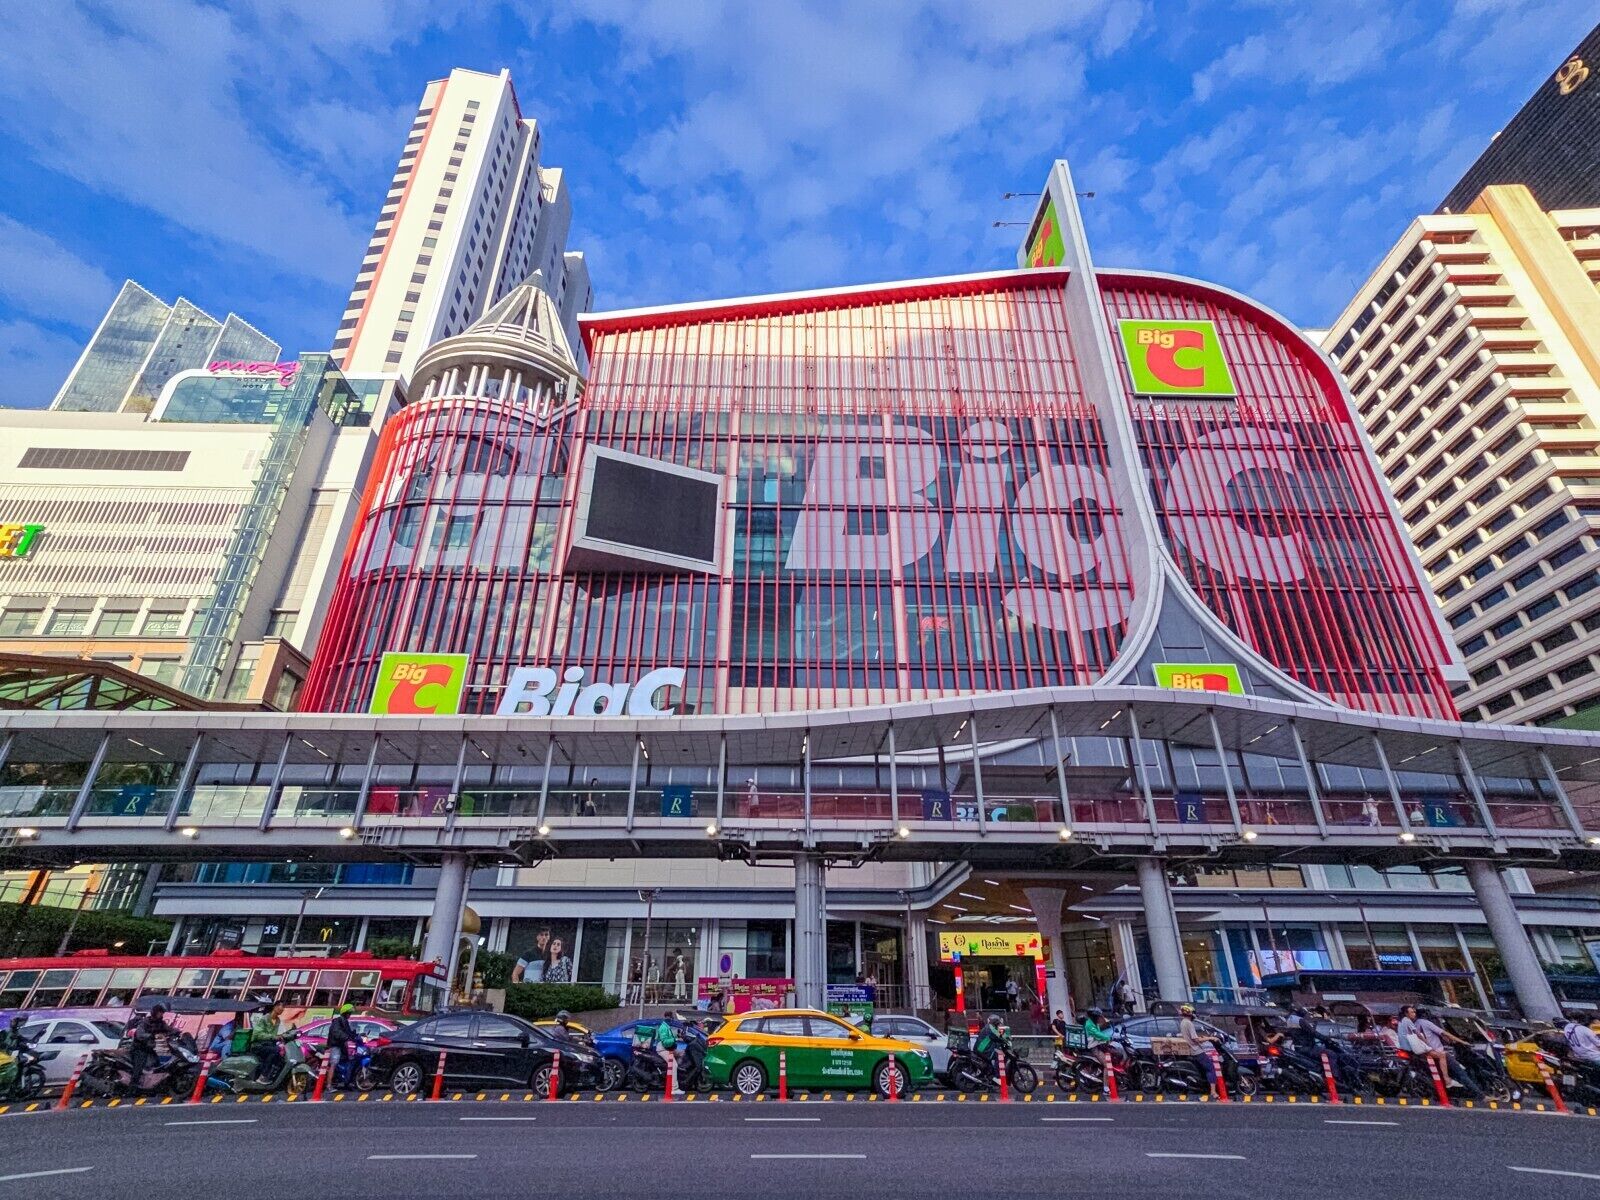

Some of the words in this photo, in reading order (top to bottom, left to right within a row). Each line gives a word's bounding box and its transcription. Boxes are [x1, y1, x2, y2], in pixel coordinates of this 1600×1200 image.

[1137, 328, 1175, 349] Big
[1146, 329, 1204, 387] C
[387, 663, 454, 714] C
[390, 663, 428, 685] Big
